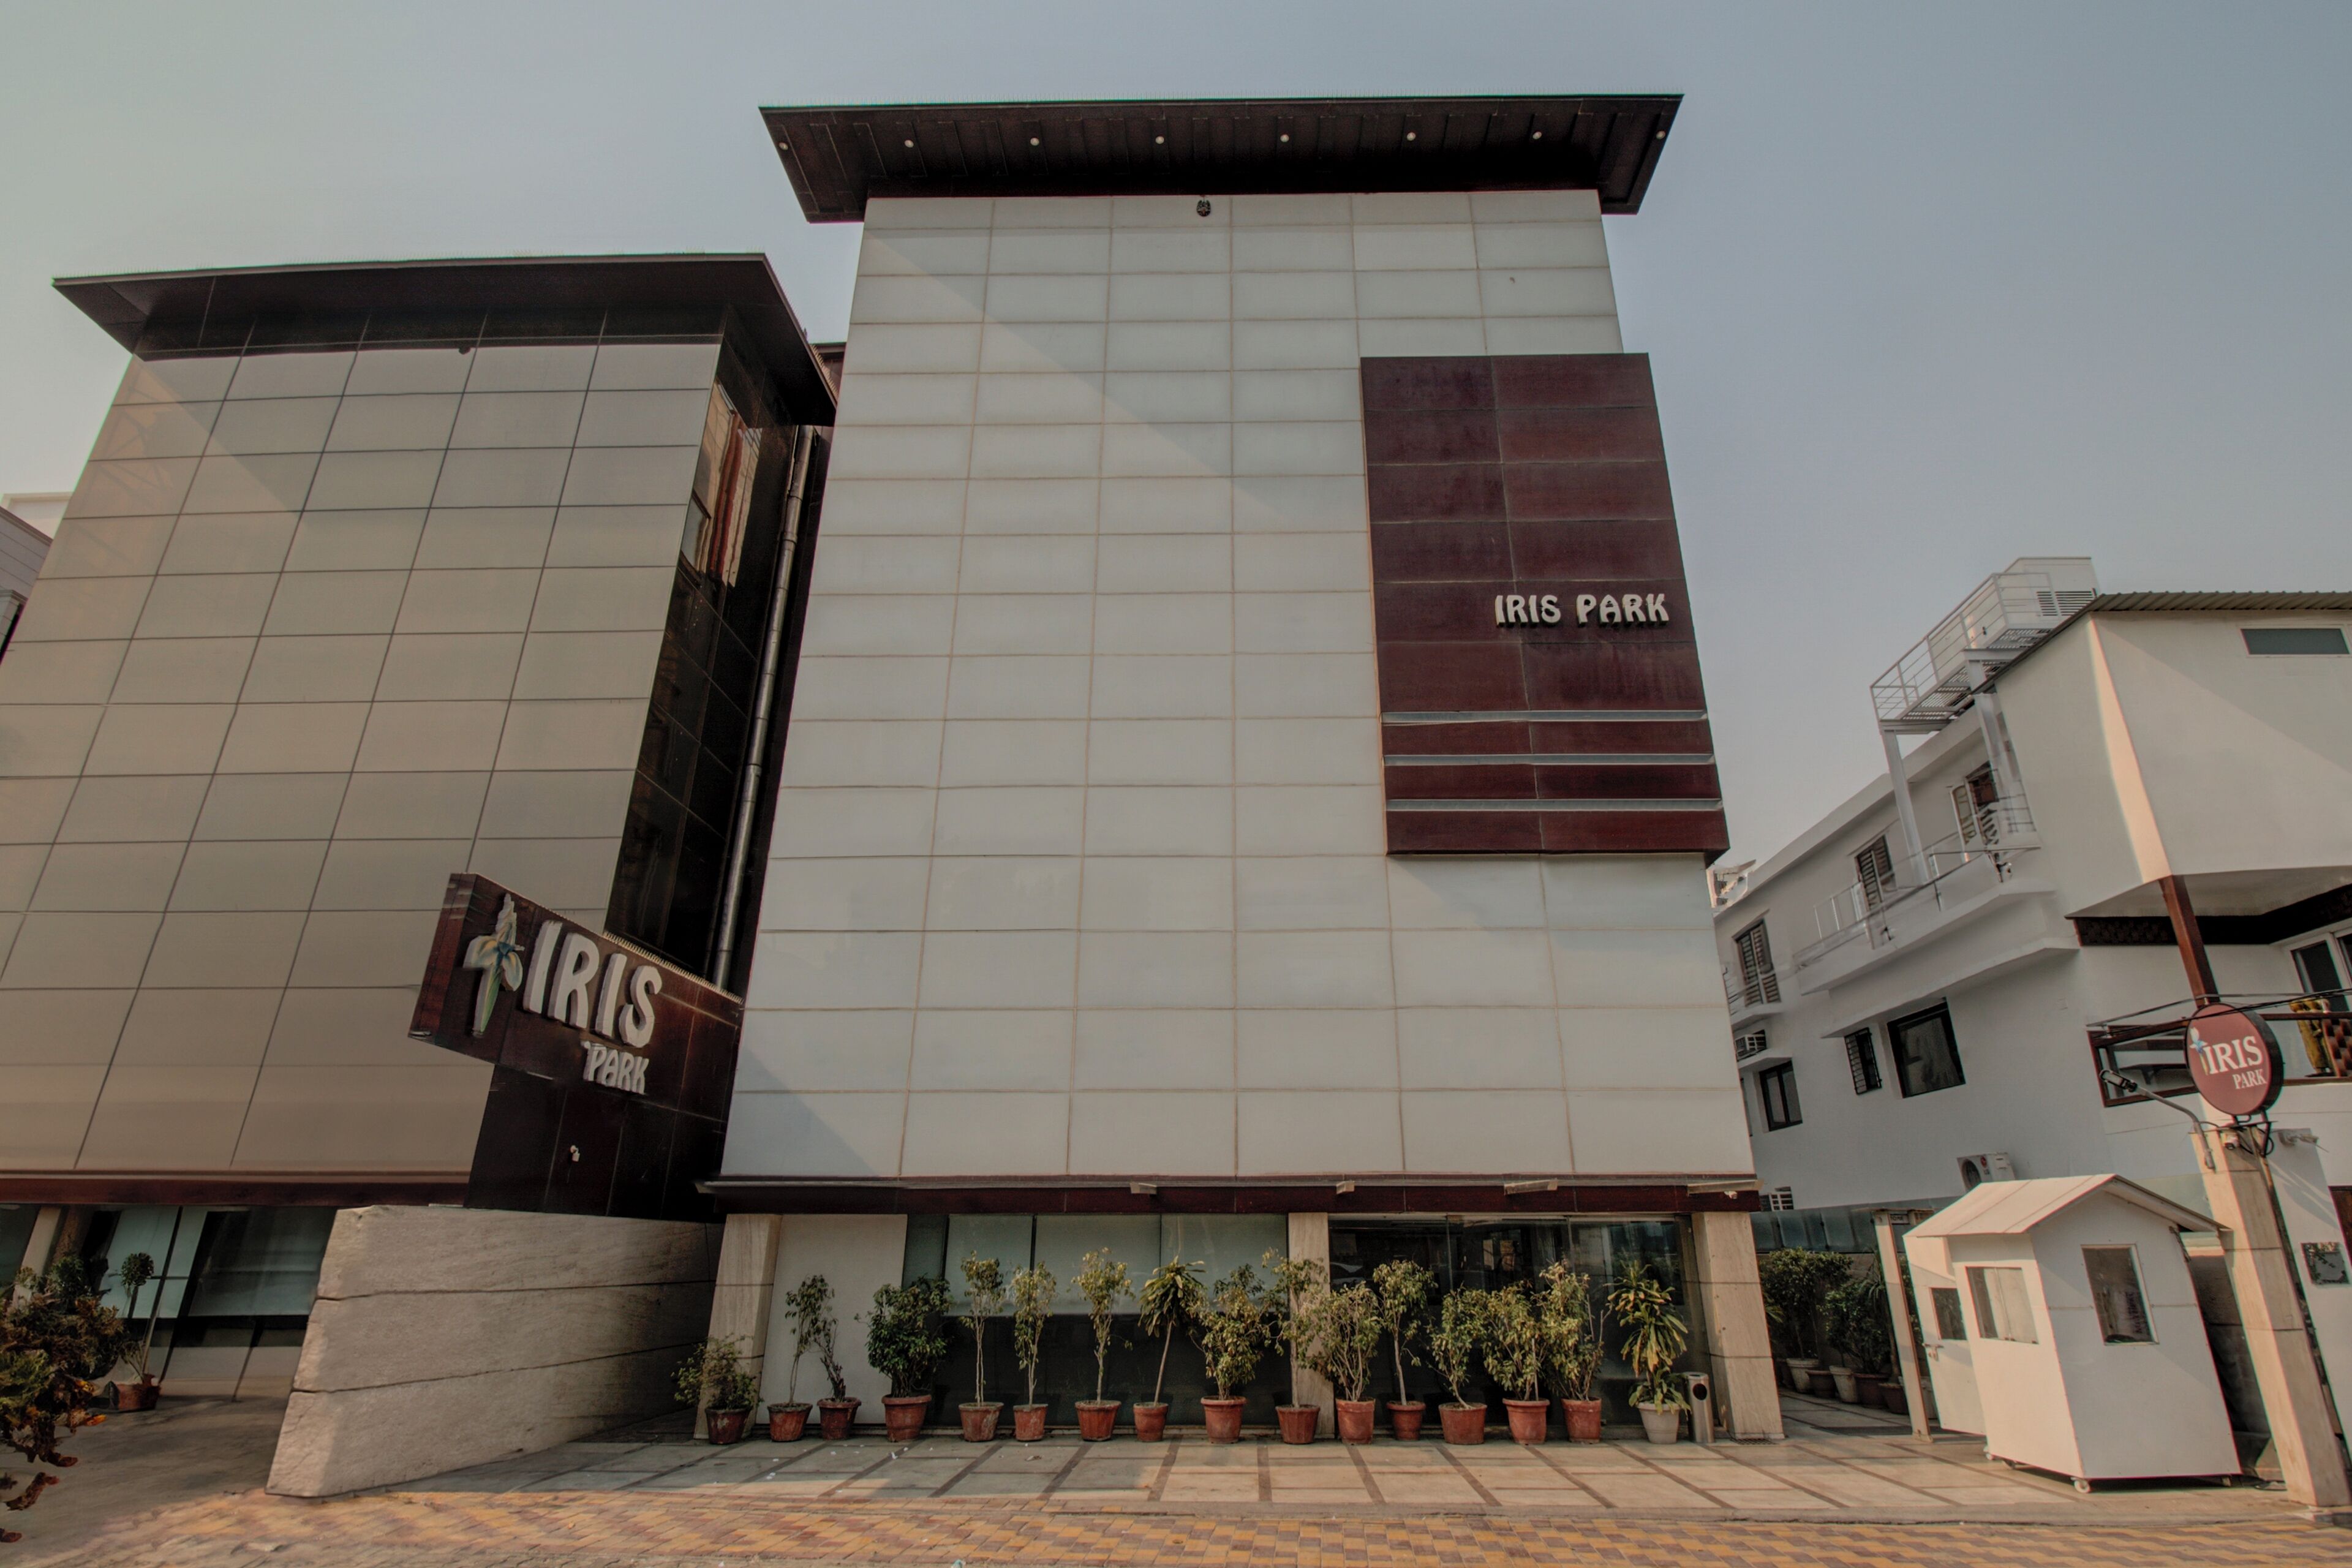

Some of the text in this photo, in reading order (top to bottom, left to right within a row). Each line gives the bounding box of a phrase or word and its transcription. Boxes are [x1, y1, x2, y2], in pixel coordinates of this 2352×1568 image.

[1495, 594, 1669, 624] IRIS PARK
[524, 921, 662, 1047] IRIS
[581, 1041, 649, 1094] PARK
[2203, 1036, 2263, 1074] IRIS
[2233, 1069, 2267, 1089] PARK
